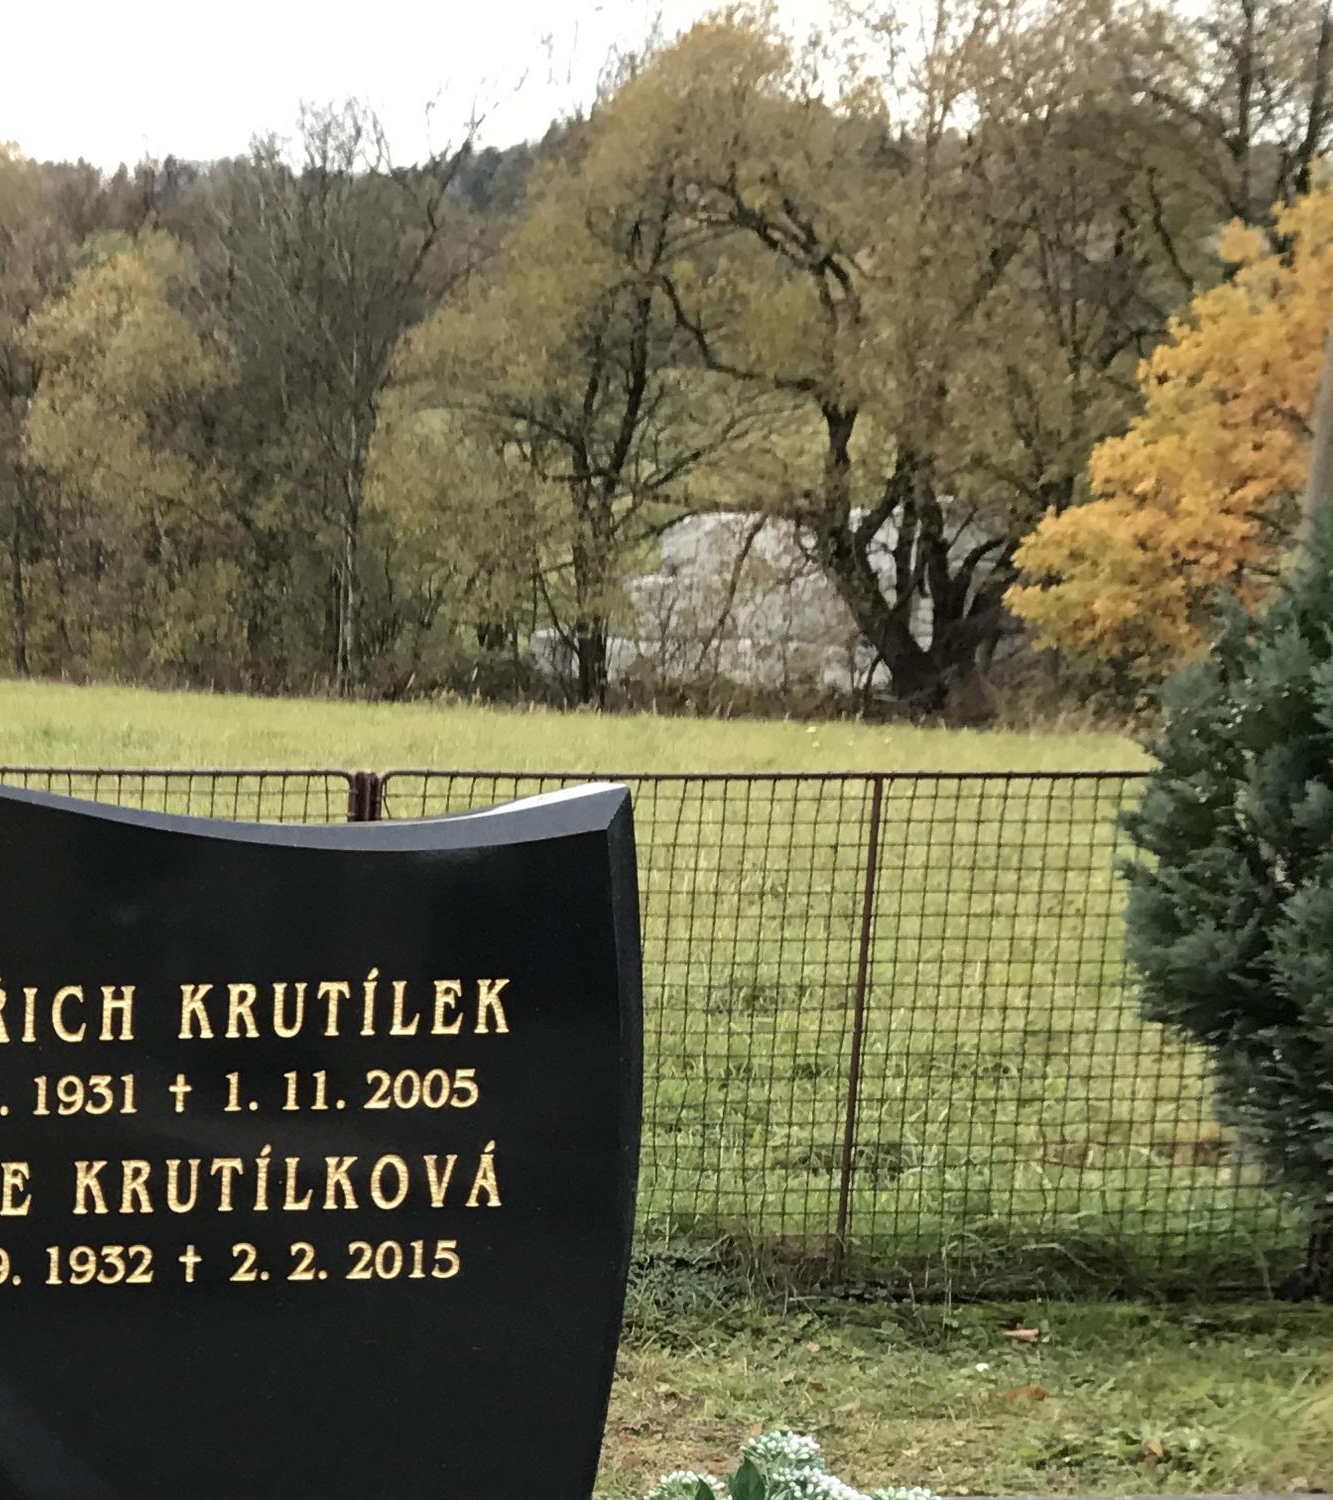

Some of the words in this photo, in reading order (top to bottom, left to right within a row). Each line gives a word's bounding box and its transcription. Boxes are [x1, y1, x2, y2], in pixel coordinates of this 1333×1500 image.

[178, 968, 511, 1039] KRUTÍLEK
[32, 1073, 138, 1116] 1931
[363, 1068, 479, 1110] 2005
[73, 1140, 503, 1214] KRUTÍLKOVÁ
[44, 1244, 154, 1285] 1932
[345, 1239, 460, 1280] 2015
